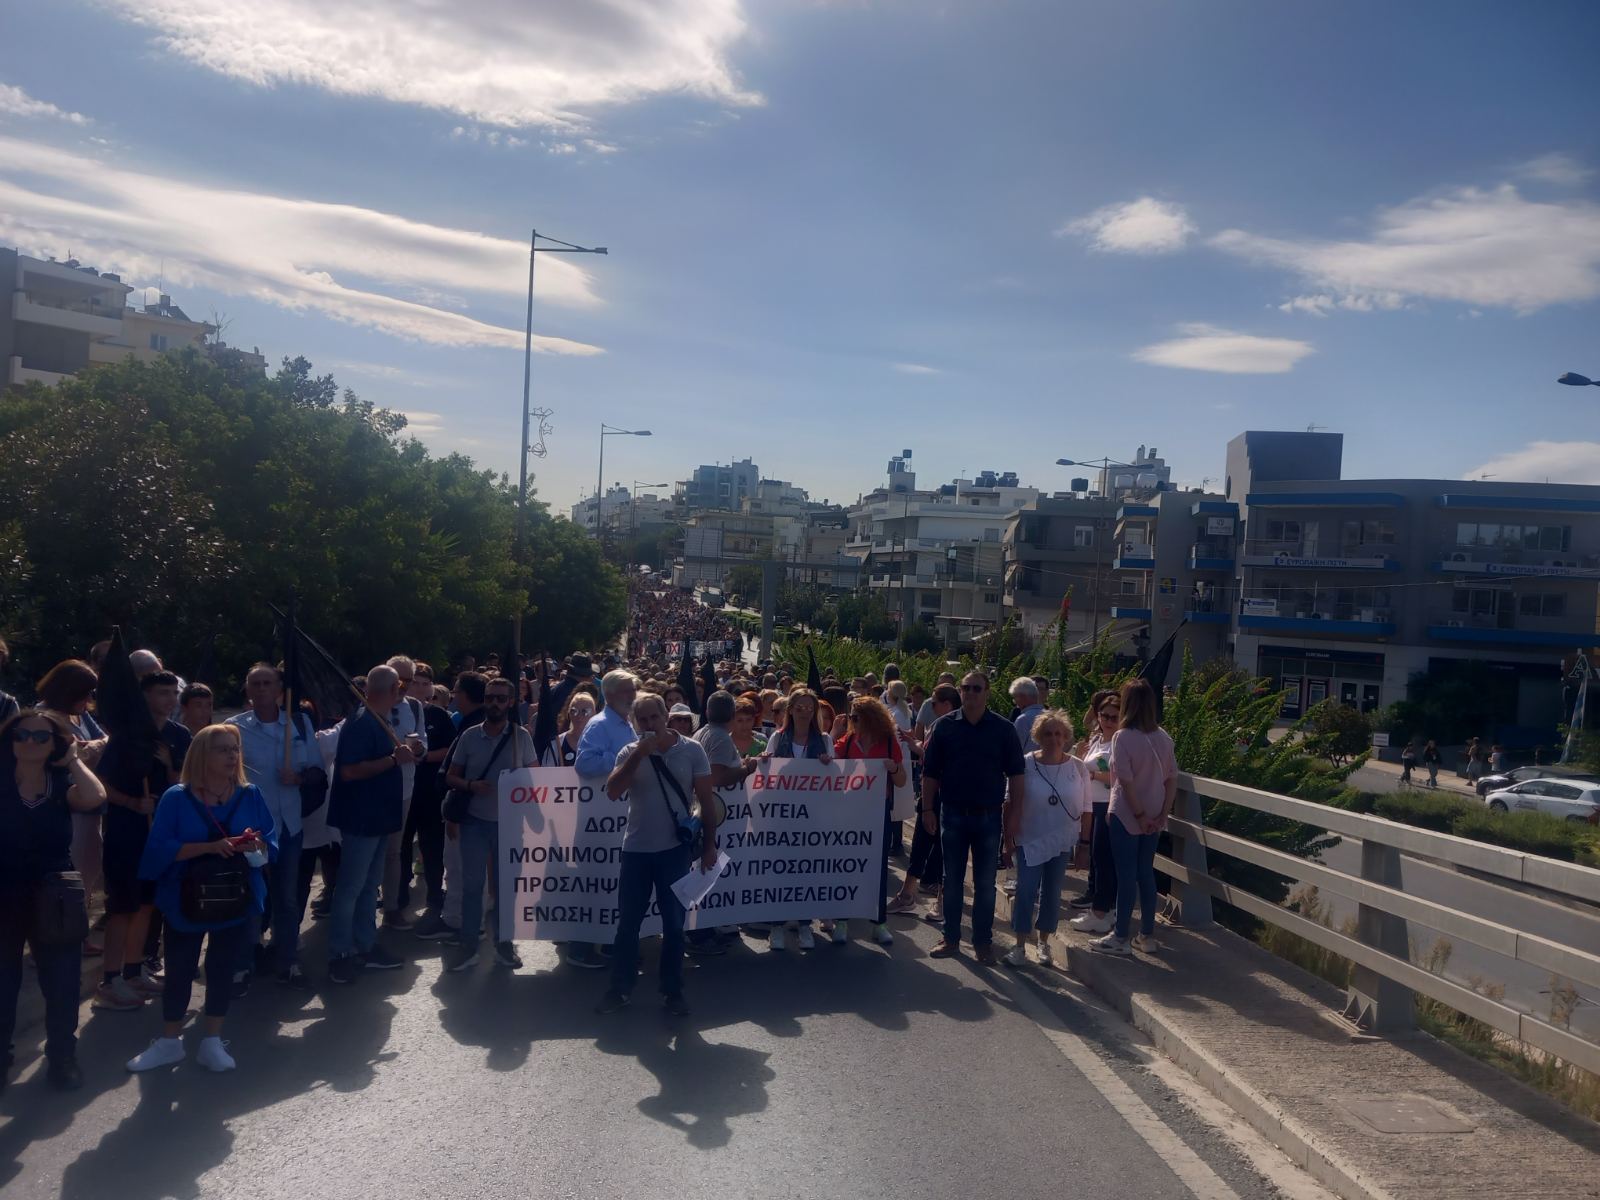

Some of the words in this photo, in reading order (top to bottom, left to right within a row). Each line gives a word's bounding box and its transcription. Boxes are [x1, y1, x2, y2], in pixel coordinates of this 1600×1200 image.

[510, 786, 548, 804] ΟΧΙ
[553, 786, 594, 804] ΣΤΟ
[752, 774, 878, 792] ΒΕΝΙΖΕΛΕΙΟΥ
[758, 802, 809, 819] ΥΓΕΙΑ
[509, 846, 622, 864] ΜΟΝΙΜΟΠ
[726, 830, 873, 849] ΣΥΜΒΑΣΙΟΥΧΩΝ
[513, 876, 618, 895] ΠΡΟΣΛΗΨ
[748, 858, 869, 877] ΠΡΟΣΩΠΙΚΟΥ
[522, 905, 592, 923] ΕΝΩΣΗ
[741, 885, 859, 906] ΒΕΝΙΖΕΛΕΙΟΥ
